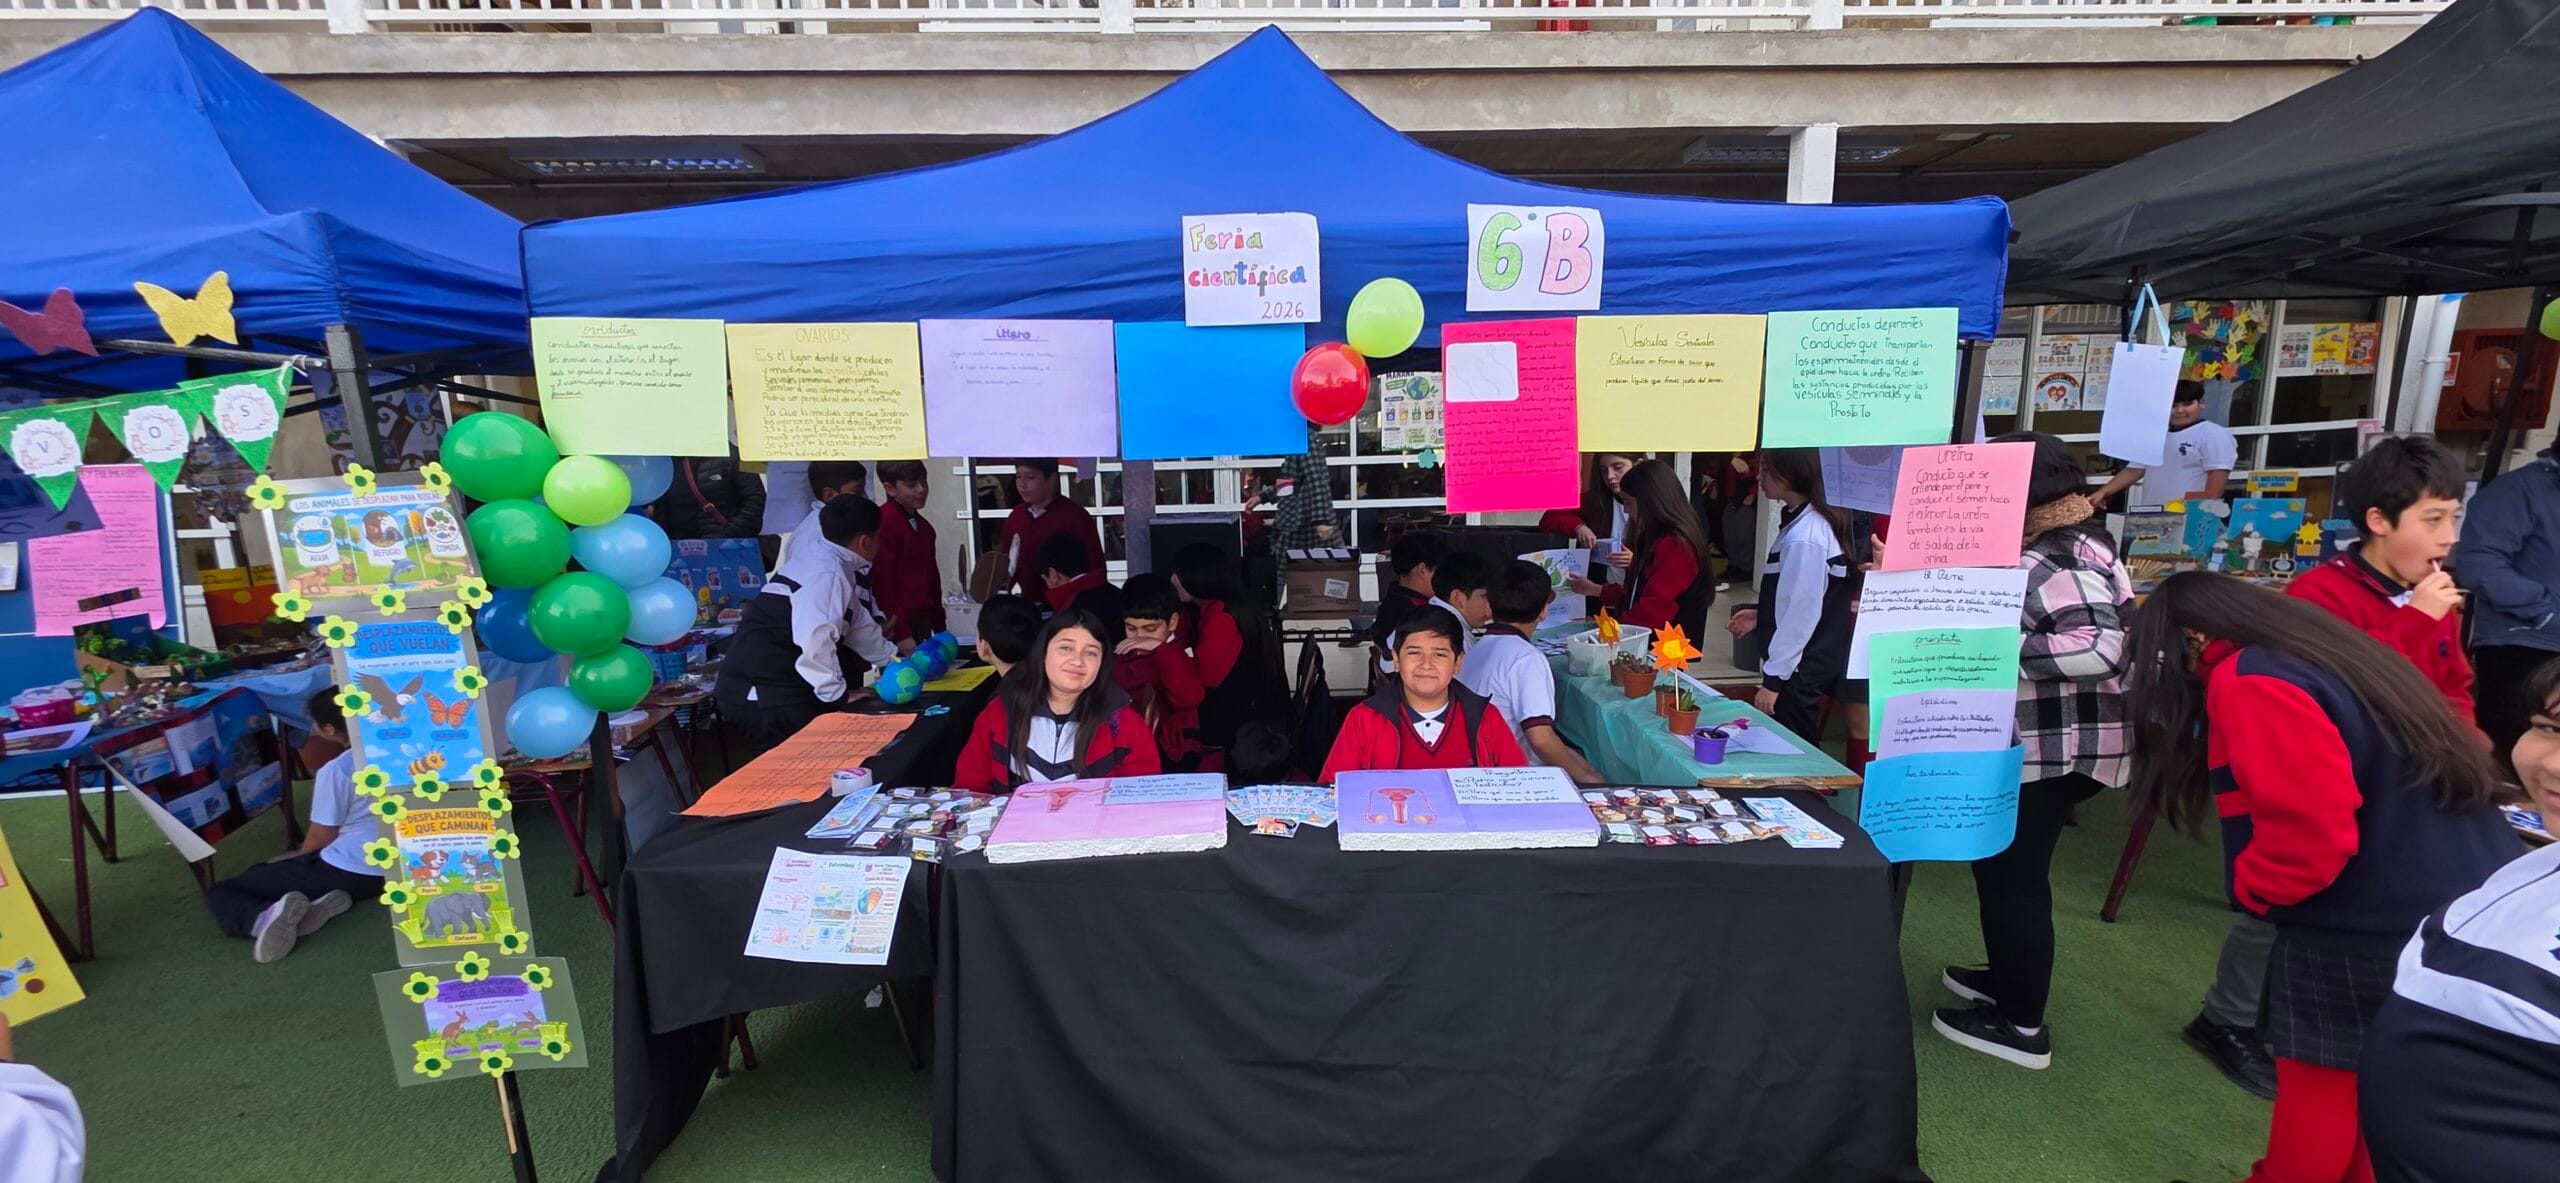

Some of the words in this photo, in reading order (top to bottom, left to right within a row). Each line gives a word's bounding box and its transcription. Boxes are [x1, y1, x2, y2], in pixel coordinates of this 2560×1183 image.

[1189, 223, 1263, 252] Feria
[1539, 212, 1592, 295] B
[1188, 262, 1306, 297] científica
[1261, 301, 1304, 320] 2026
[1811, 317, 1870, 332] Conductos
[1874, 317, 1923, 334] deferentes
[795, 328, 849, 343] OVARIOS
[1618, 323, 1667, 348] Vesículas
[1801, 334, 1856, 350] Conductos
[1859, 340, 1878, 355] que
[790, 350, 811, 366] lugar
[815, 353, 838, 363] donde
[856, 355, 893, 367] producen
[1795, 353, 1809, 366] los
[1886, 357, 1909, 366] desde
[1913, 357, 1919, 366] el
[1839, 366, 1859, 376] hacia
[1651, 378, 1661, 386] que
[1793, 378, 1805, 389] las
[1898, 383, 1912, 393] por
[1904, 394, 1910, 402] y
[1914, 391, 1922, 400] la
[149, 425, 161, 439] O
[240, 404, 250, 418] S
[1916, 468, 1954, 483] Conducto
[1958, 471, 1974, 480] que
[1979, 471, 1989, 479] se
[1942, 484, 1955, 495] por
[1965, 484, 1981, 495] pene
[1984, 485, 1990, 493] y
[312, 498, 350, 508] ANIMALES
[352, 497, 361, 505] SE
[362, 495, 400, 505] DESPLAZAN
[400, 494, 417, 502] PARA
[418, 492, 442, 501] BUSCAR
[1910, 494, 1942, 505] conduce
[1946, 494, 1953, 502] el
[1990, 493, 2010, 503] hacia
[1949, 507, 1960, 519] La
[1963, 506, 1989, 520] uretra
[1959, 523, 1967, 533] la
[436, 544, 460, 553] COMIDA
[1910, 540, 1920, 550] de
[1957, 541, 1969, 550] de
[1972, 538, 1980, 549] la
[310, 554, 329, 562] AGUA
[373, 547, 402, 556] REFUGIO
[1924, 555, 1947, 564] orina
[368, 640, 395, 654] QUE
[401, 638, 449, 650] VUELAN
[415, 822, 438, 833] QUE
[440, 821, 488, 831] CAMINAN
